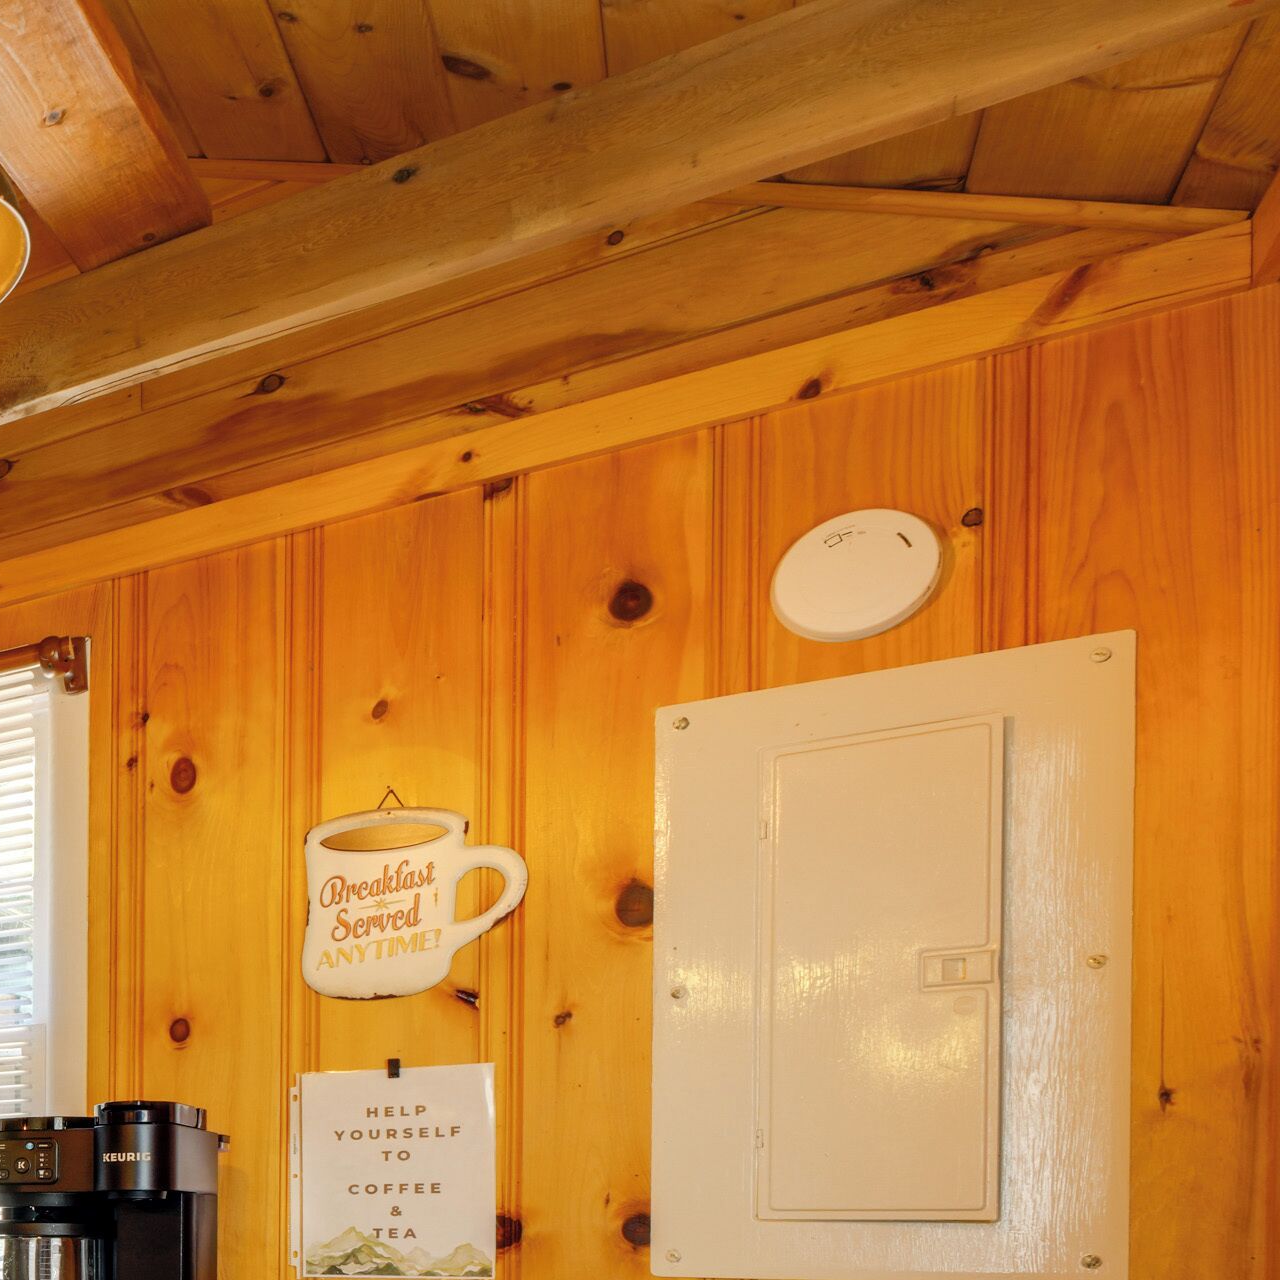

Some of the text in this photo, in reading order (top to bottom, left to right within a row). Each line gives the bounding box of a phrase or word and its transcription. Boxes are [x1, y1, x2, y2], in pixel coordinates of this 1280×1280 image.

[320, 859, 435, 908] Breakfast
[331, 892, 422, 942] Served
[316, 928, 442, 971] ANYTIME!
[366, 1105, 427, 1118] HELP
[334, 1126, 461, 1141] YOURSELF
[102, 1152, 151, 1163] KEURIG
[381, 1150, 411, 1161] TO
[17, 1161, 26, 1169] K
[348, 1183, 441, 1195] COFFEE
[390, 1205, 402, 1217] &
[372, 1228, 417, 1239] TEA
